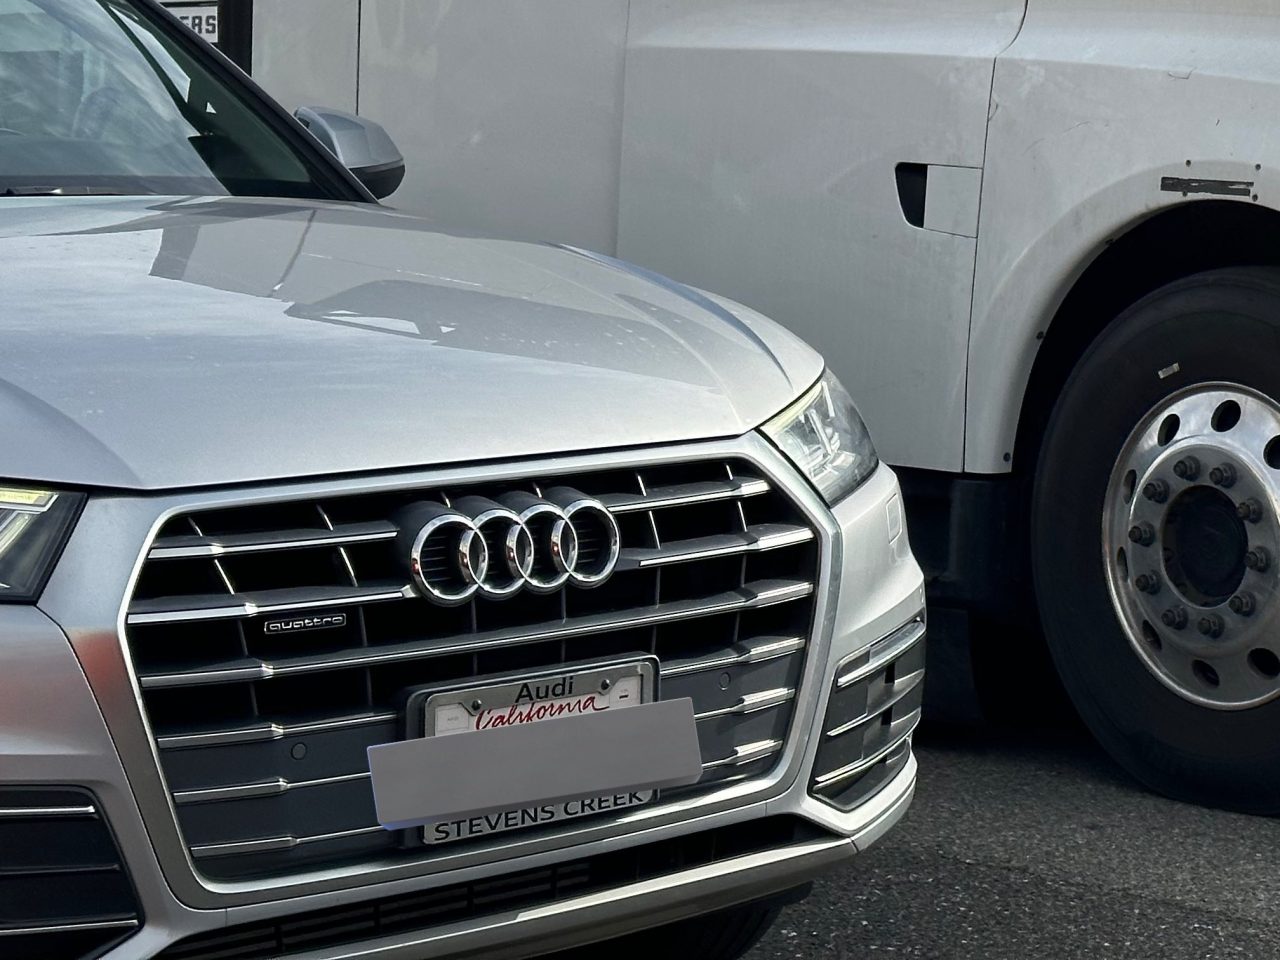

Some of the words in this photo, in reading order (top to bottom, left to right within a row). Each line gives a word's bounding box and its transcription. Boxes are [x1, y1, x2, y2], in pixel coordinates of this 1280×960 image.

[269, 616, 344, 631] quattro
[514, 675, 575, 703] Audi
[434, 804, 555, 841] STEVENS
